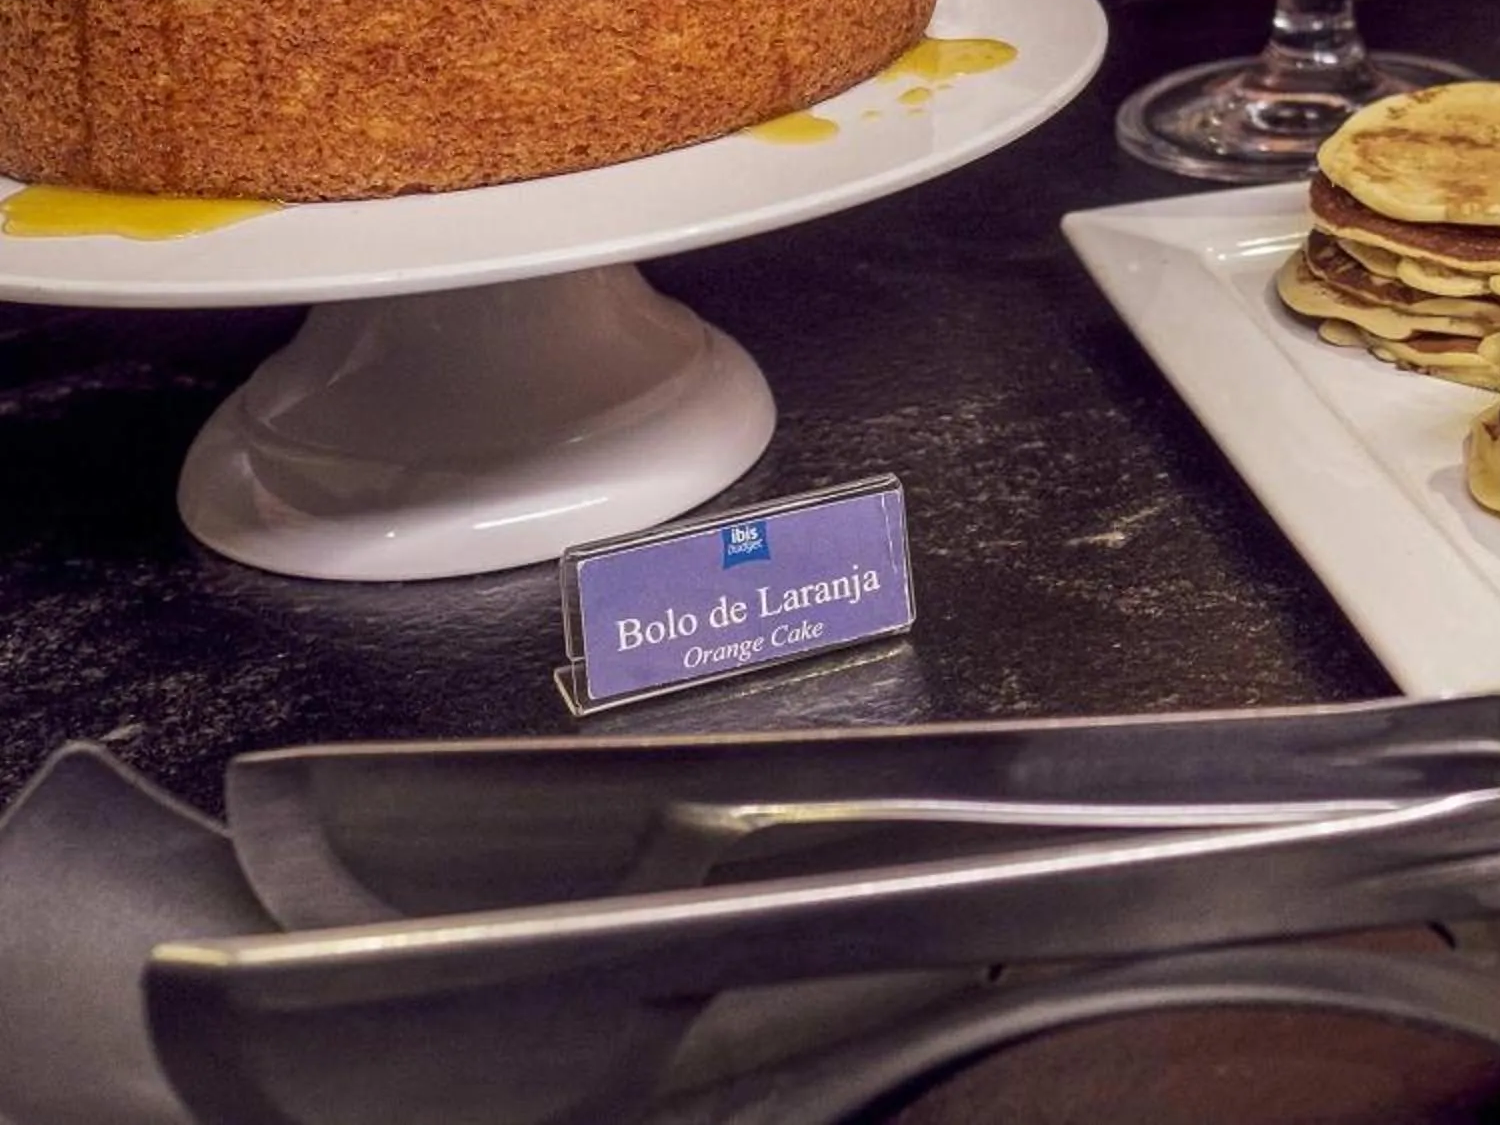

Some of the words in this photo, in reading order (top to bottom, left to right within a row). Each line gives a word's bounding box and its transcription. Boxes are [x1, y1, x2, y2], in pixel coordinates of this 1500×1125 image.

[731, 525, 759, 544] ibis
[615, 607, 698, 652] Bolo
[708, 595, 748, 628] de
[757, 564, 880, 618] Laranja
[683, 633, 765, 669] Orange
[770, 620, 824, 648] Cake
